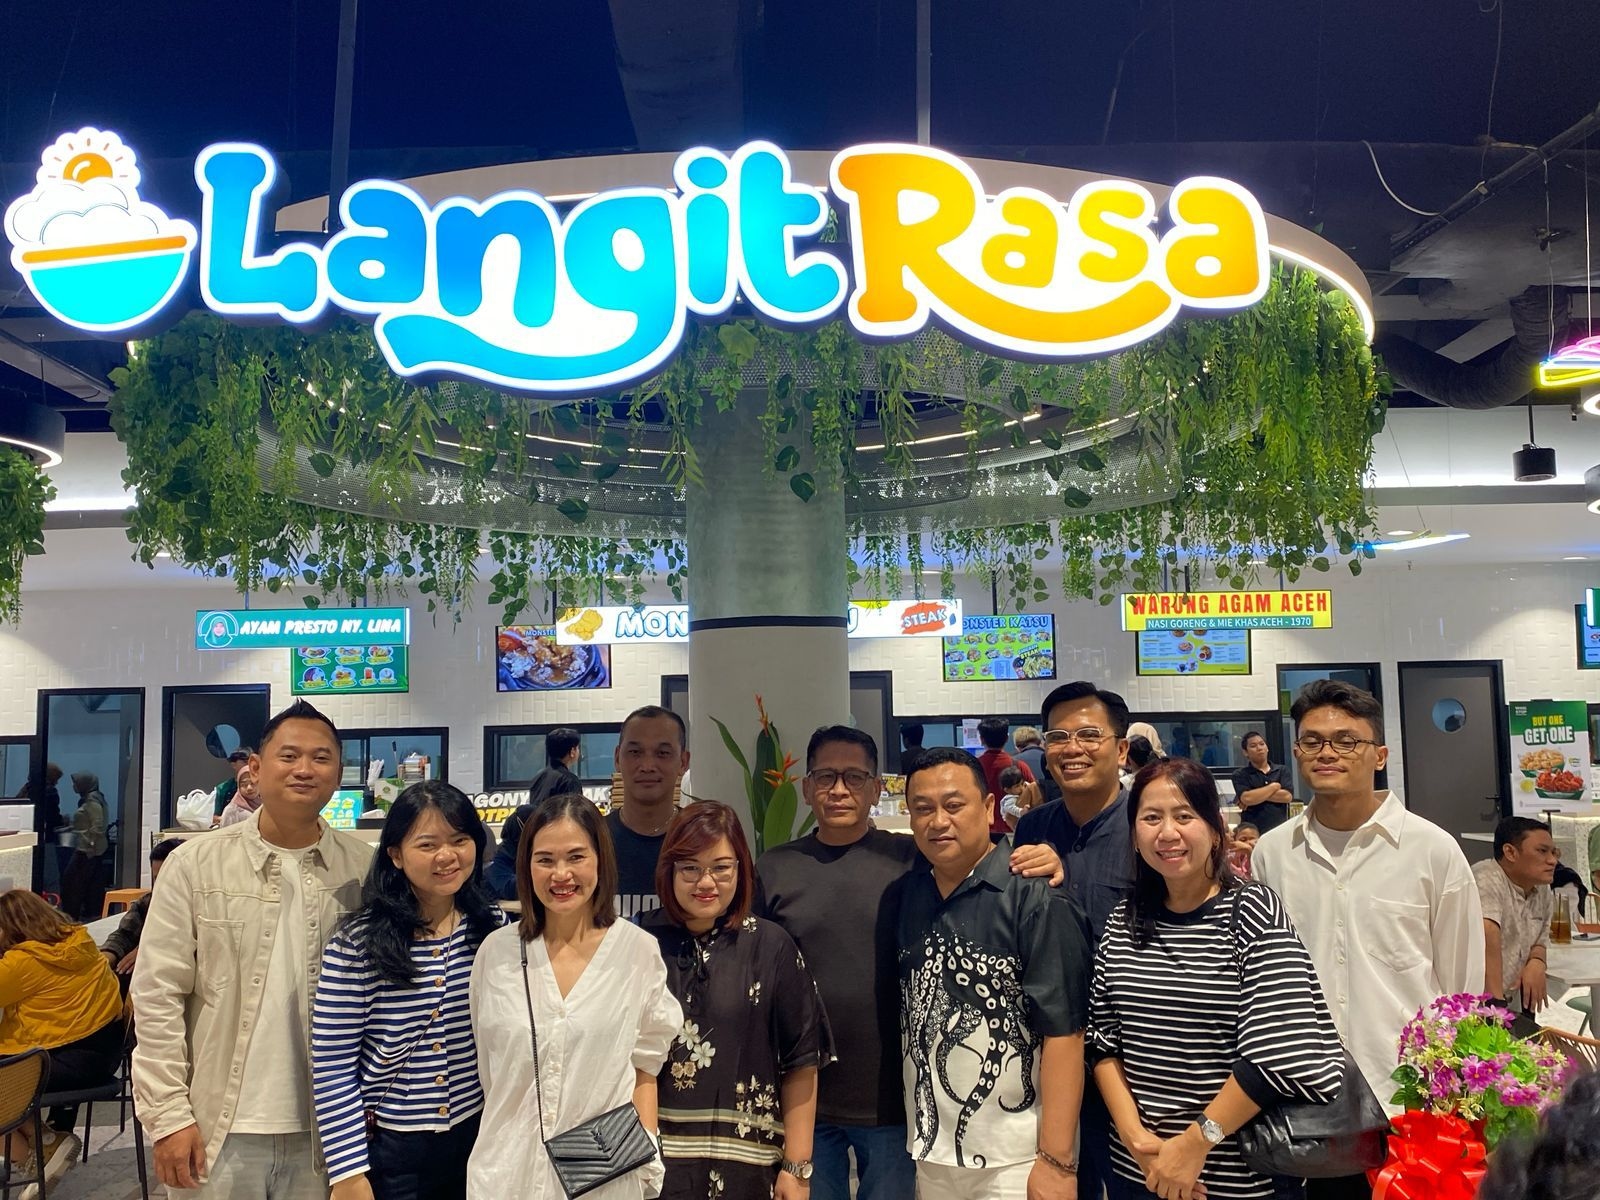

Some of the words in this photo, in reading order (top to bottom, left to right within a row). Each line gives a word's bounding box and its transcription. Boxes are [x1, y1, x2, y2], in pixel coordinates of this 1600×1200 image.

[195, 141, 848, 391] Langit
[830, 144, 1271, 355] Rasa
[1132, 594, 1209, 615] WARUNG
[1219, 593, 1271, 614] AGAM
[1281, 592, 1327, 612] ACEH
[240, 620, 280, 635] AYAM
[284, 619, 339, 635] PRESTO
[340, 618, 363, 634] NY.
[367, 618, 400, 633] LINA
[903, 608, 948, 629] STEAK
[1009, 615, 1049, 629] KATSU
[1148, 619, 1168, 628] NASI
[1170, 619, 1207, 628] GORENG
[1209, 619, 1216, 627] &
[1217, 618, 1233, 627] MIE
[1234, 618, 1258, 627] KHAS
[1259, 617, 1283, 626] ACEH
[1290, 617, 1311, 626] 1970
[525, 629, 556, 637] MONSTE
[1532, 716, 1547, 726] BUY
[1548, 715, 1564, 725] ONE
[1524, 727, 1548, 744] GET
[1549, 726, 1573, 742] ONE
